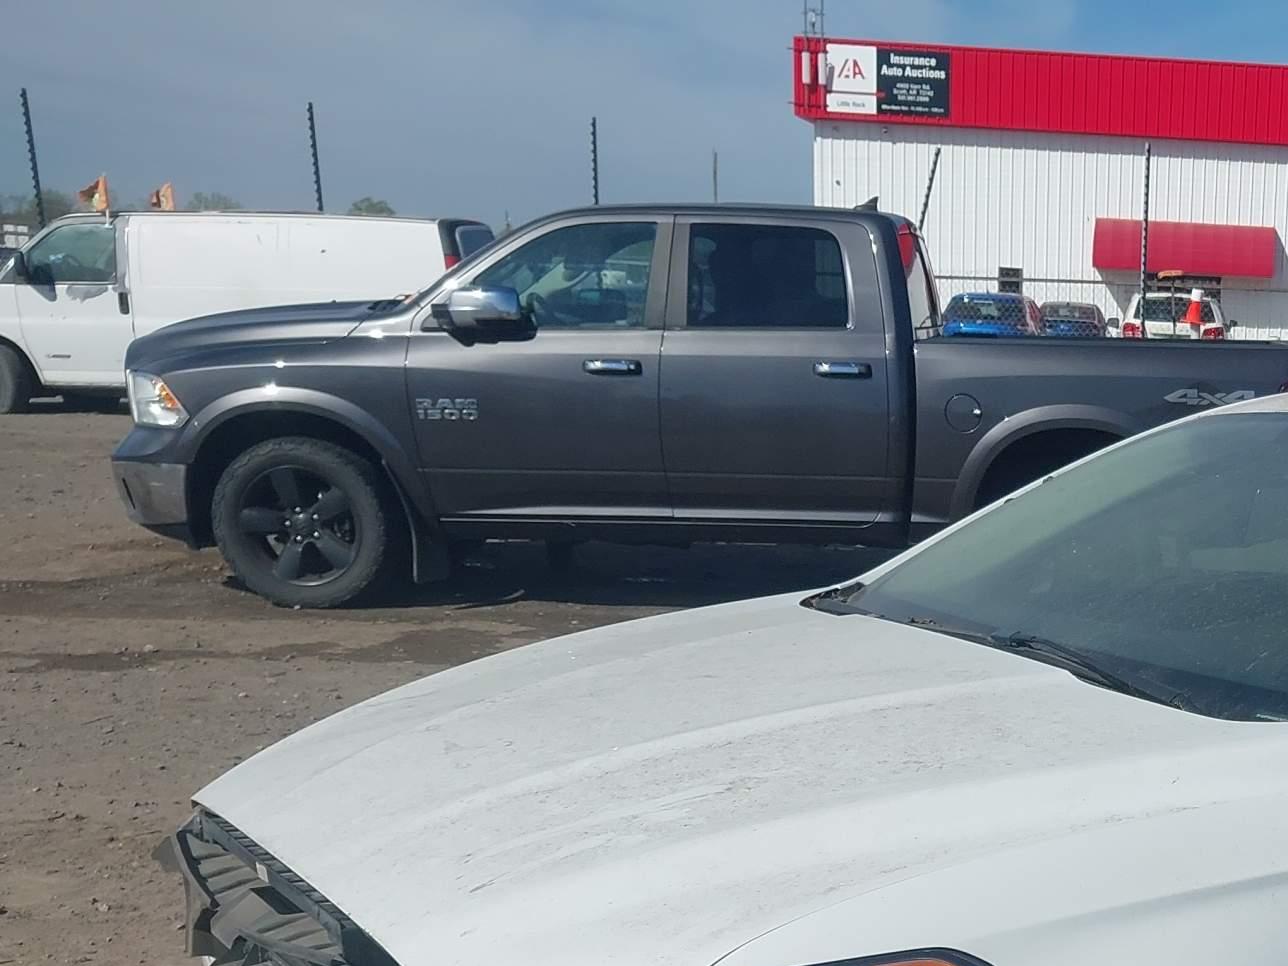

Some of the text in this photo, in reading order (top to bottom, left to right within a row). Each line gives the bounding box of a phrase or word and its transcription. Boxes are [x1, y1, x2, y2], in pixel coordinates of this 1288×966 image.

[890, 53, 937, 66] Insurance
[881, 64, 946, 79] Auto Auctions
[415, 398, 478, 408] RAM
[416, 409, 478, 420] 1500
